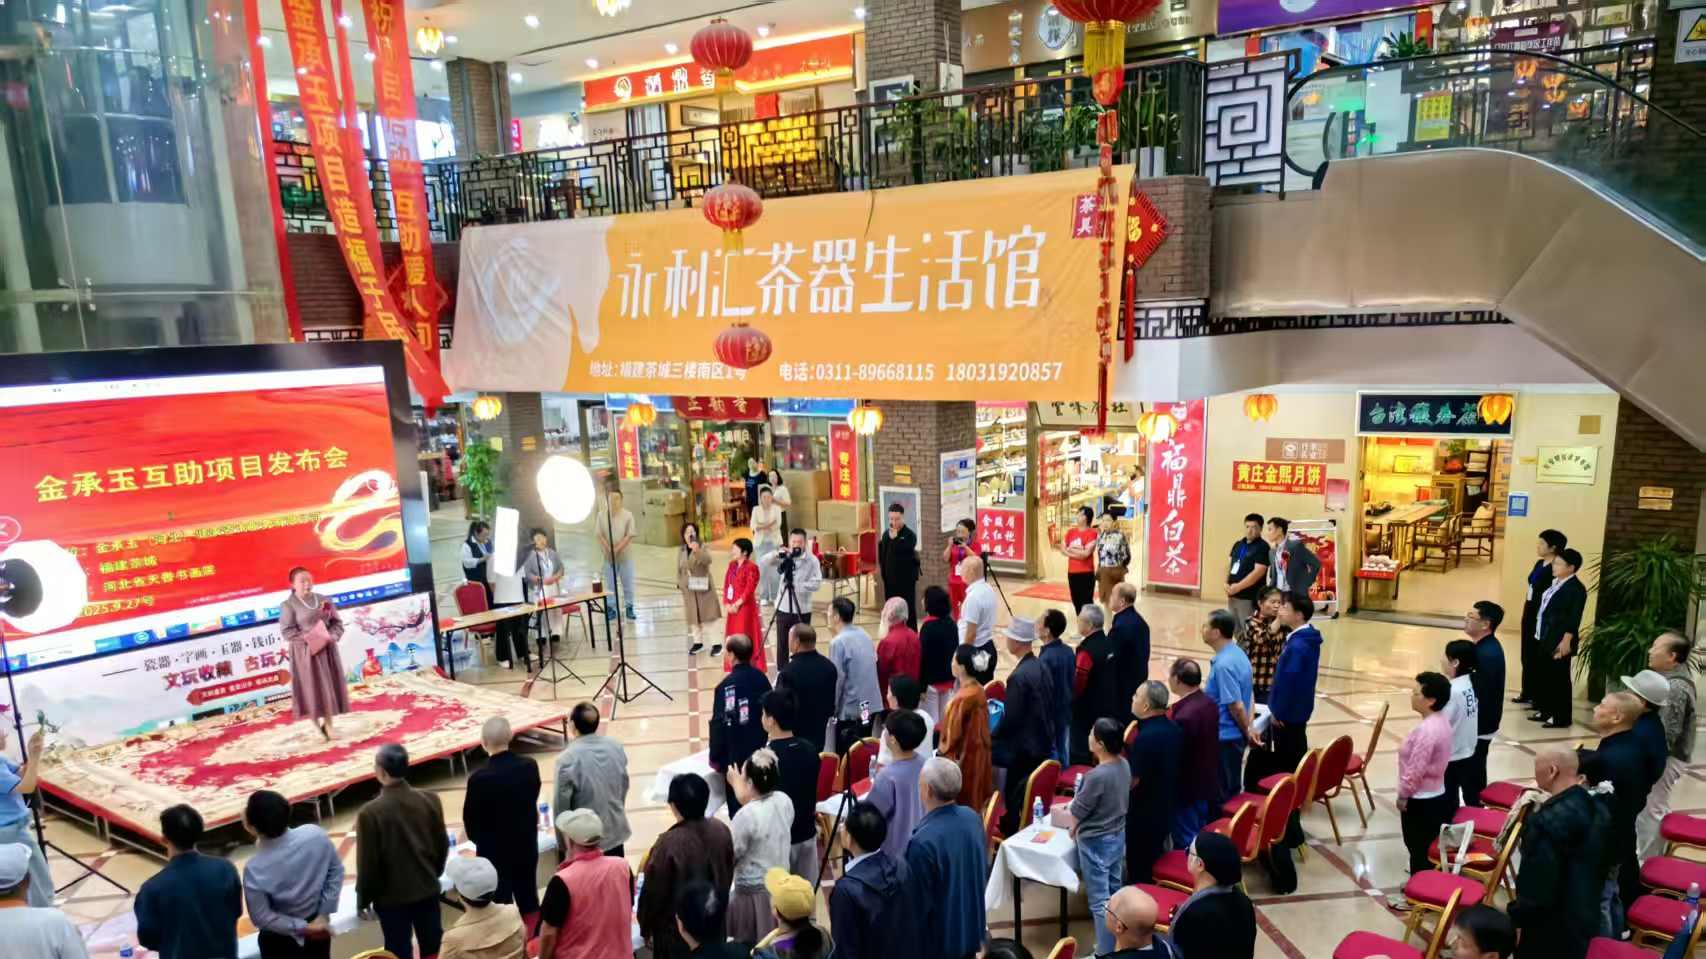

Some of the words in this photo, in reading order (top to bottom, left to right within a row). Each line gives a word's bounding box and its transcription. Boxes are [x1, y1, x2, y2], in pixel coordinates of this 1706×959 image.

[1077, 196, 1096, 236] 茶具
[617, 224, 1048, 320] 永利汇茶器生活馆
[945, 361, 1064, 382] 18031920857
[34, 445, 349, 503] 金承玉互助项目发布会
[1160, 437, 1189, 577] 福鼎白茶
